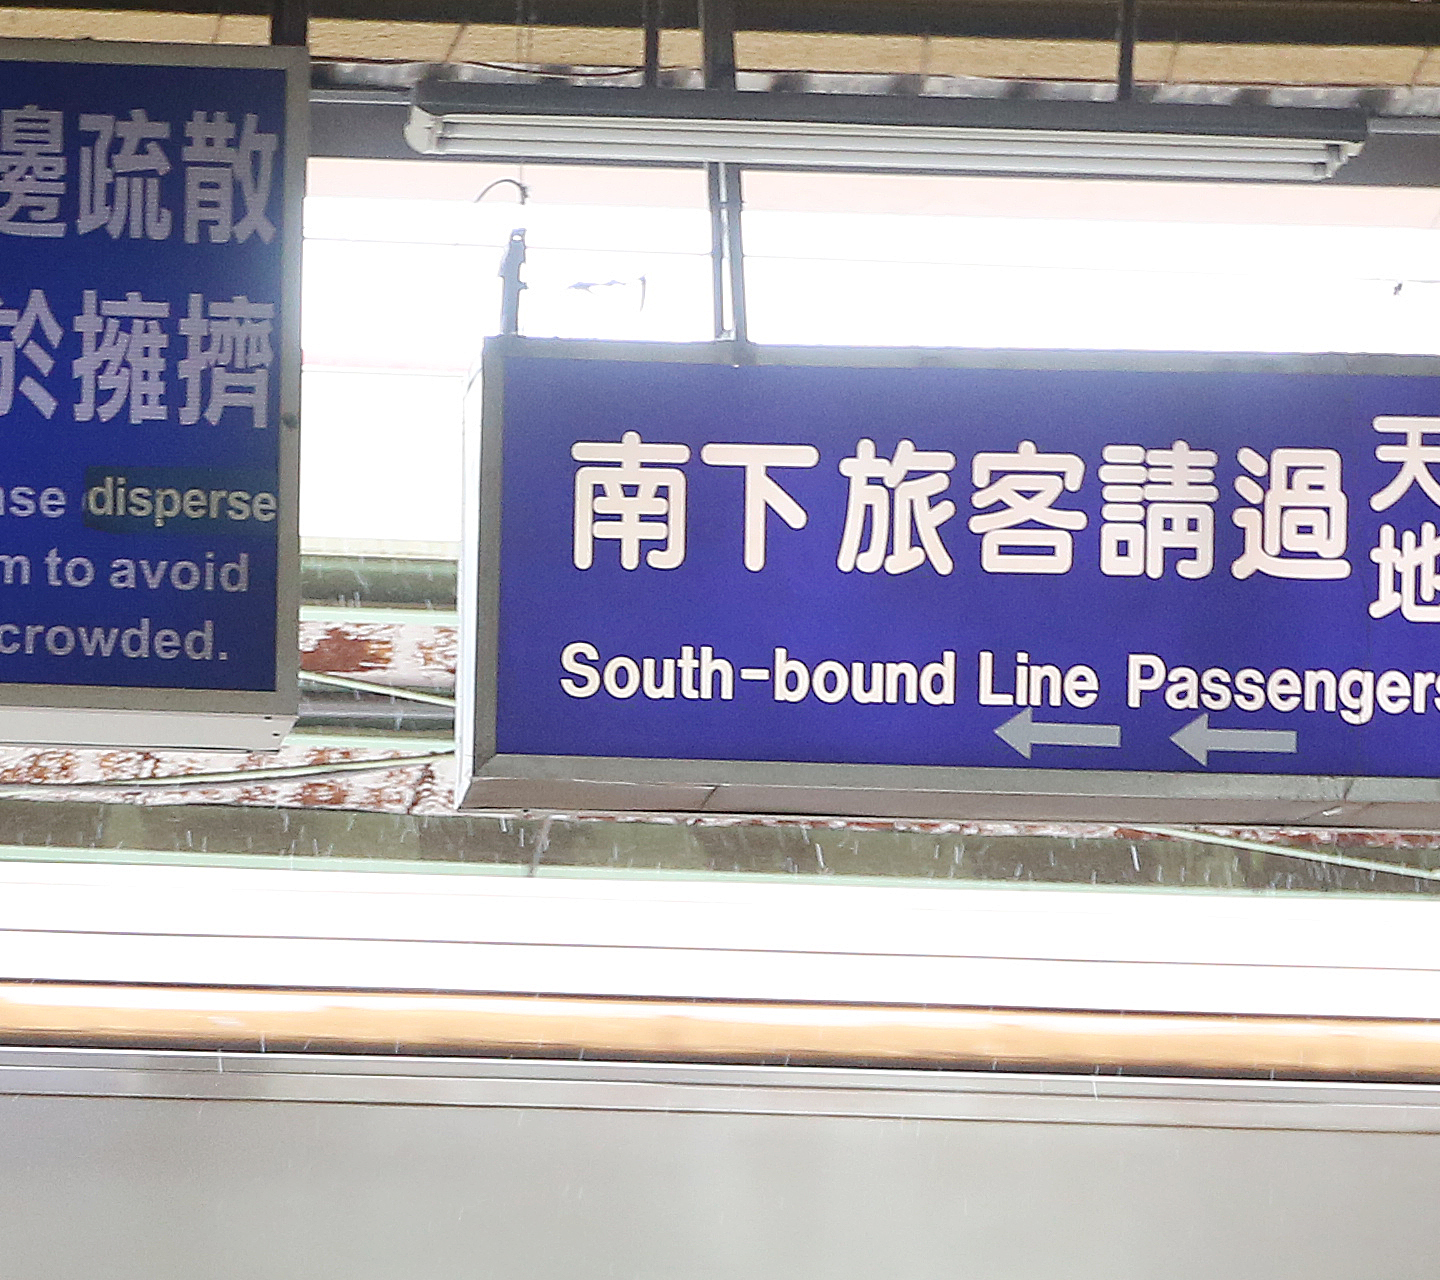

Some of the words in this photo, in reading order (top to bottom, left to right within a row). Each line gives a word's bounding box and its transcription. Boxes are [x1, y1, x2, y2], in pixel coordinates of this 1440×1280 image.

[85, 476, 278, 528] disperse
[44, 548, 96, 588] to
[110, 553, 249, 593] avoid
[559, 641, 957, 706] South-bound
[978, 651, 1100, 708] Line
